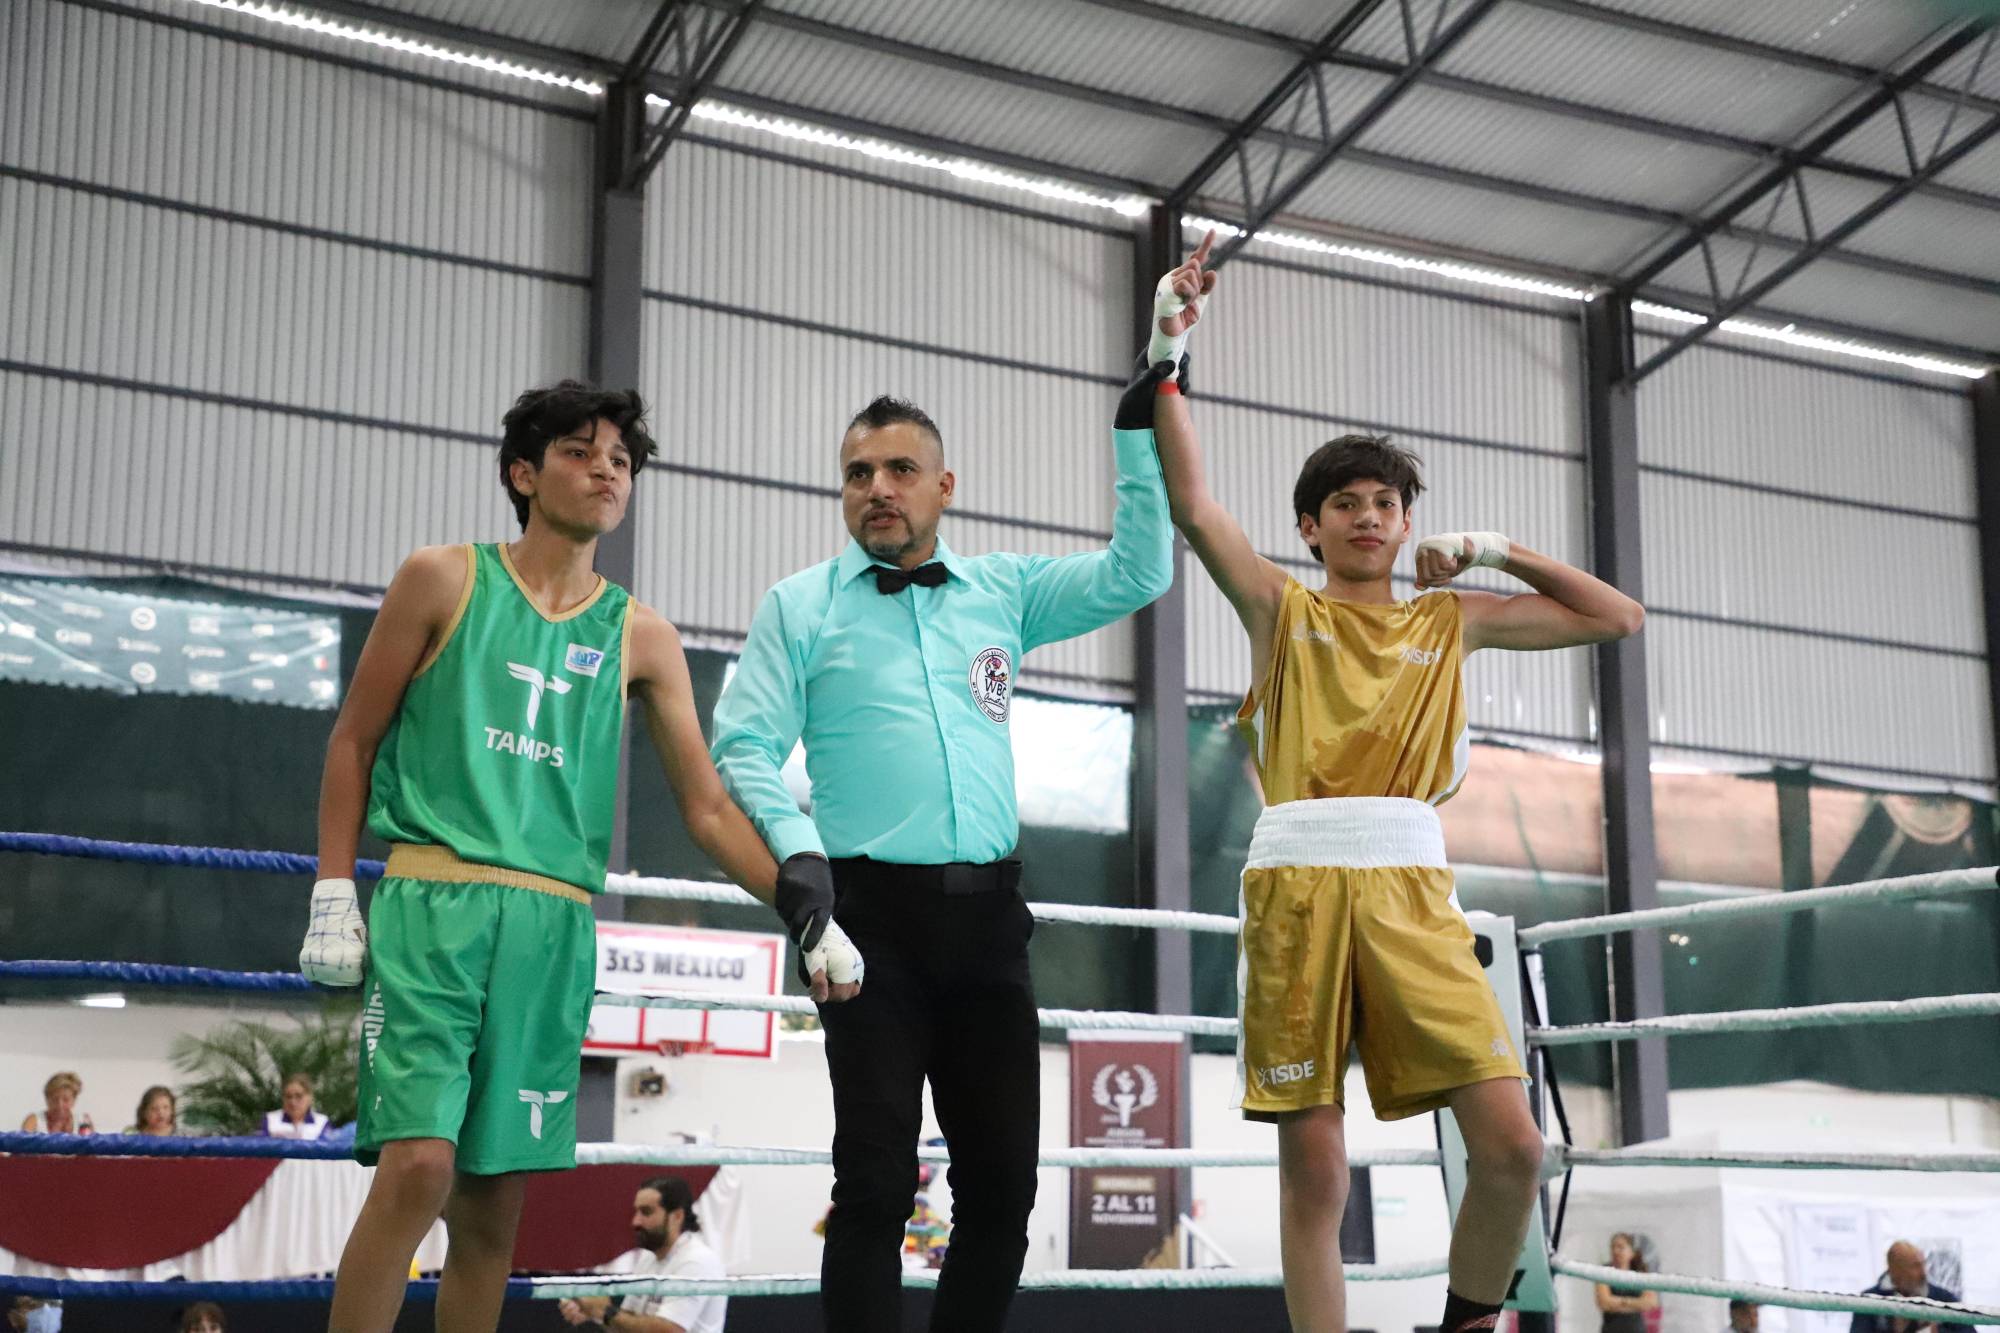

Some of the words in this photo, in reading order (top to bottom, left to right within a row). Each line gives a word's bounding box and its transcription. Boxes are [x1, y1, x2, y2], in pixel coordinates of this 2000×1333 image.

[484, 726, 565, 768] TAMPS
[605, 947, 645, 974] 3x3
[1270, 1058, 1316, 1086] ISDE
[1091, 1194, 1106, 1212] 2
[1107, 1194, 1133, 1212] AL
[1135, 1194, 1156, 1212] 11
